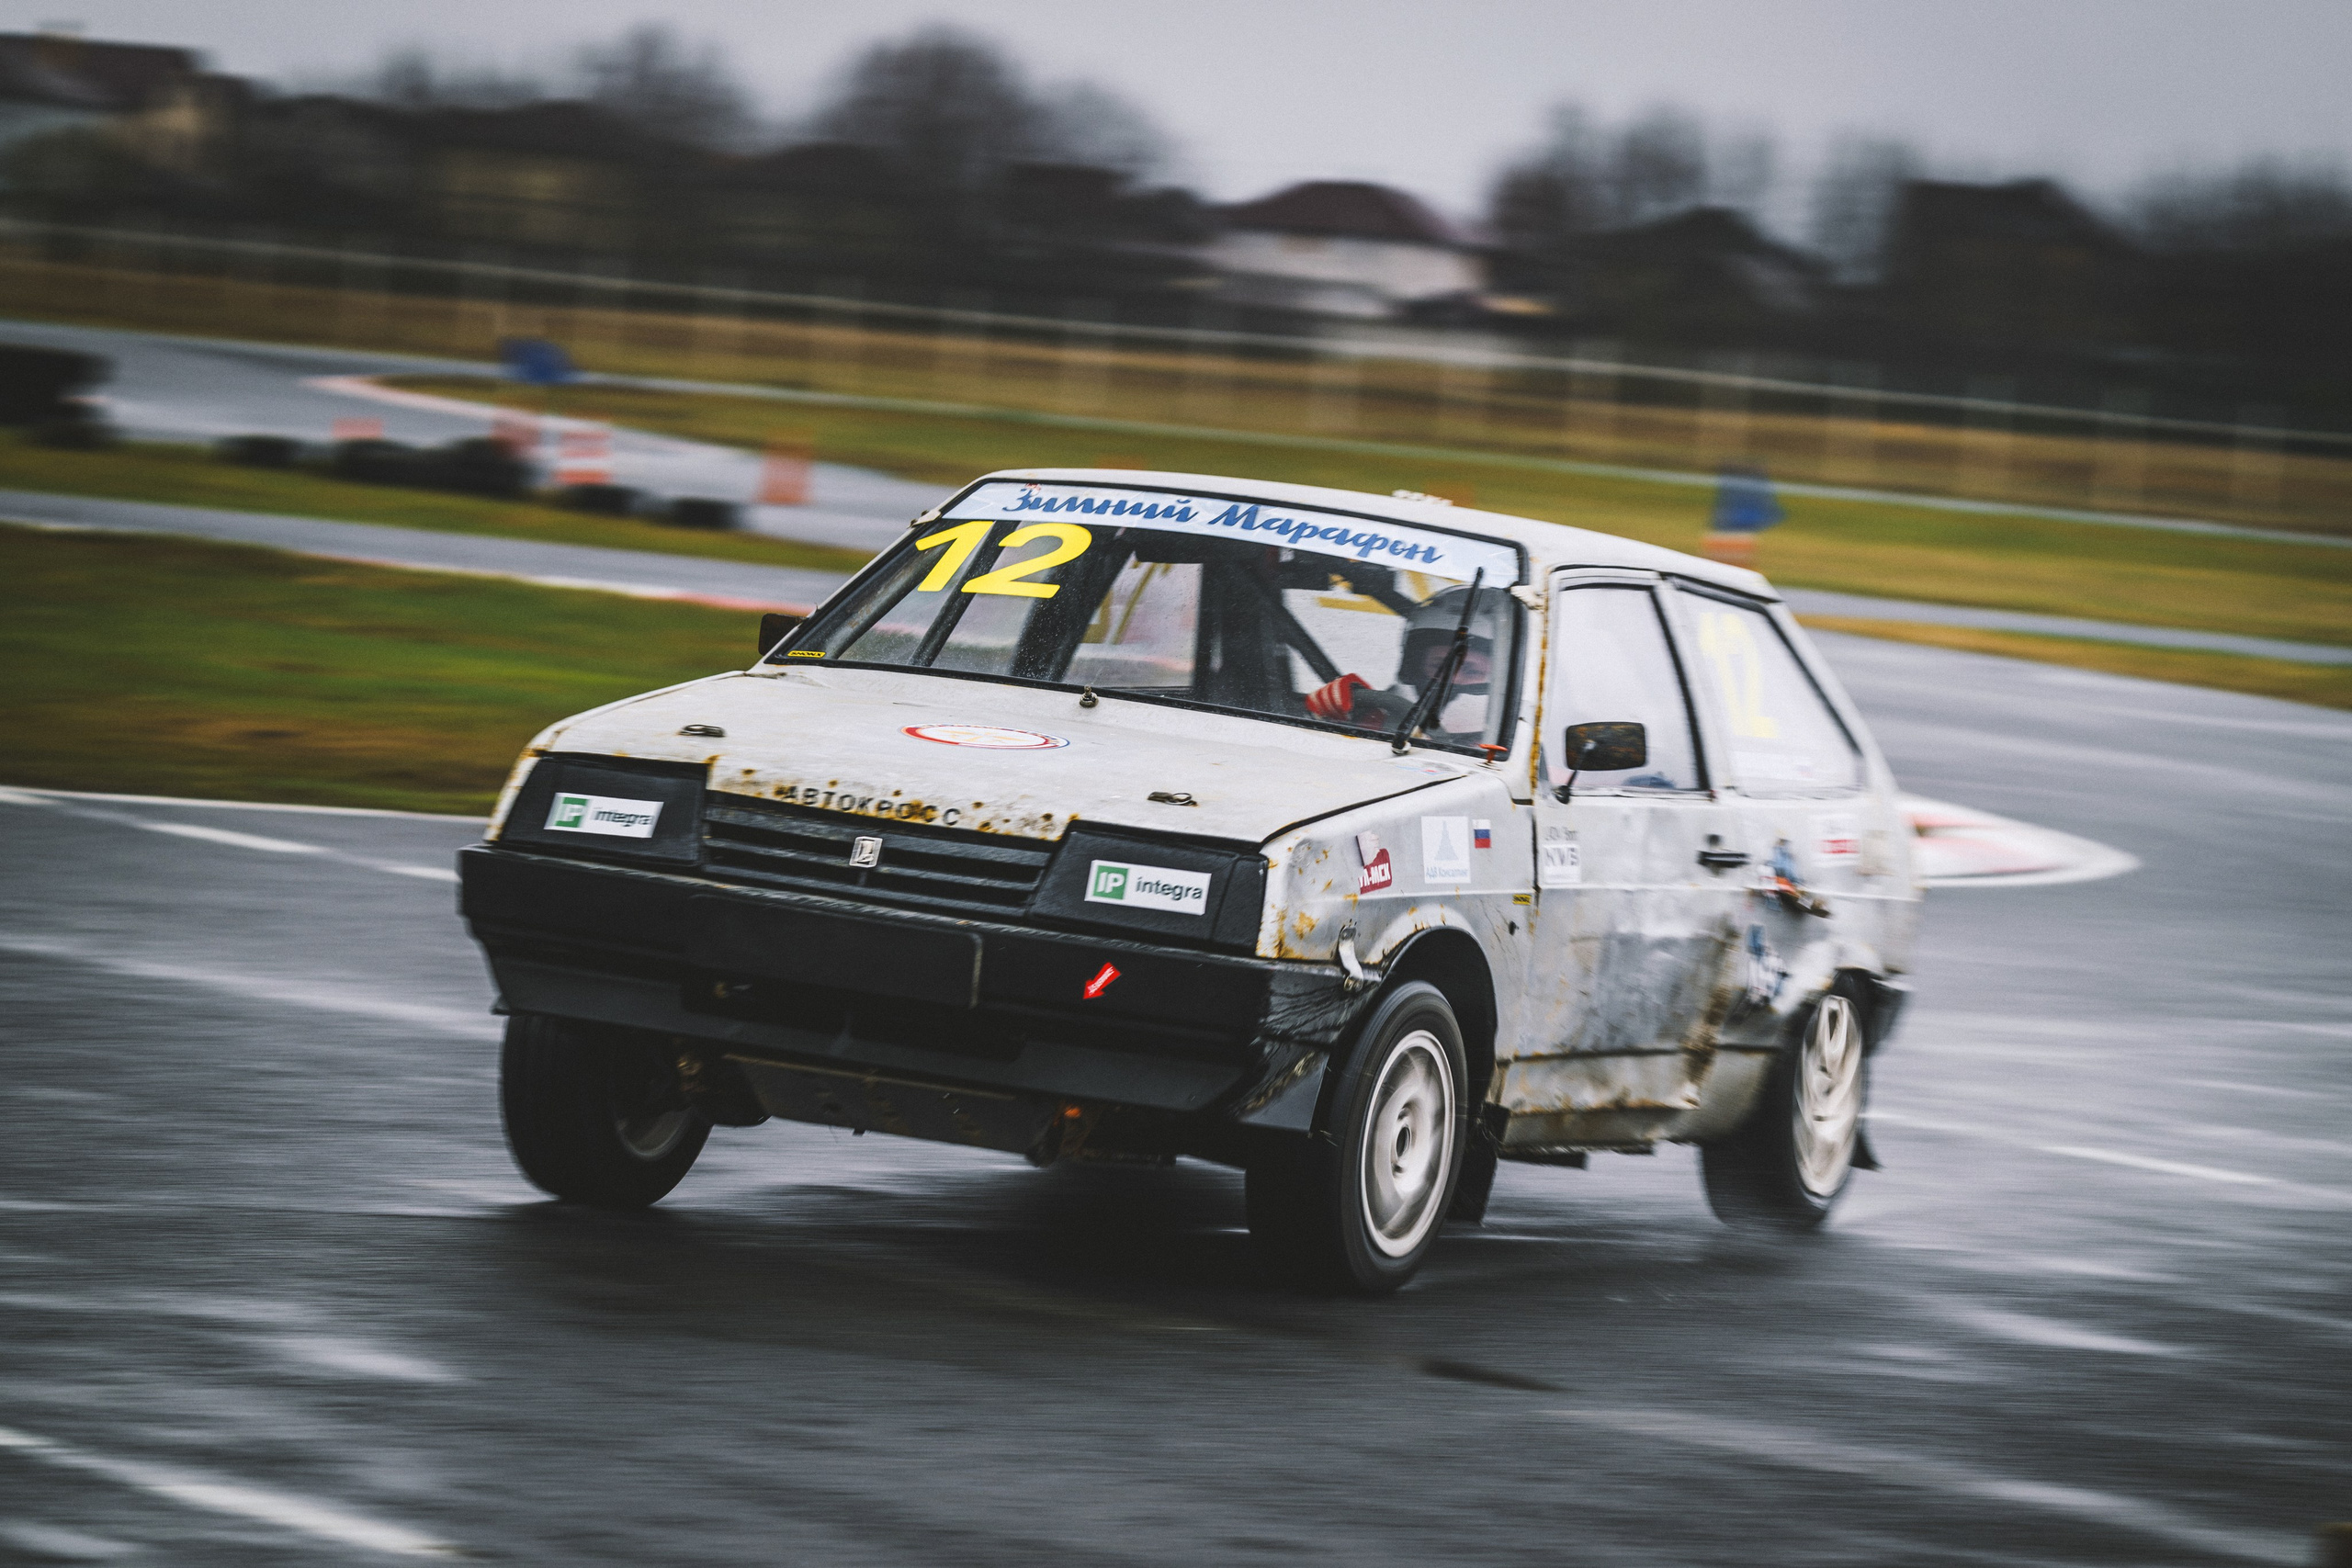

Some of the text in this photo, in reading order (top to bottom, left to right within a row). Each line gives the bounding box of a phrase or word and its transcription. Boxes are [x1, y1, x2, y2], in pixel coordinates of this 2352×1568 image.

[1002, 488, 1199, 523] Зимний
[915, 521, 1092, 598] 12
[781, 785, 961, 826] АВТОКРОСС
[1096, 871, 1203, 901] IP integra
